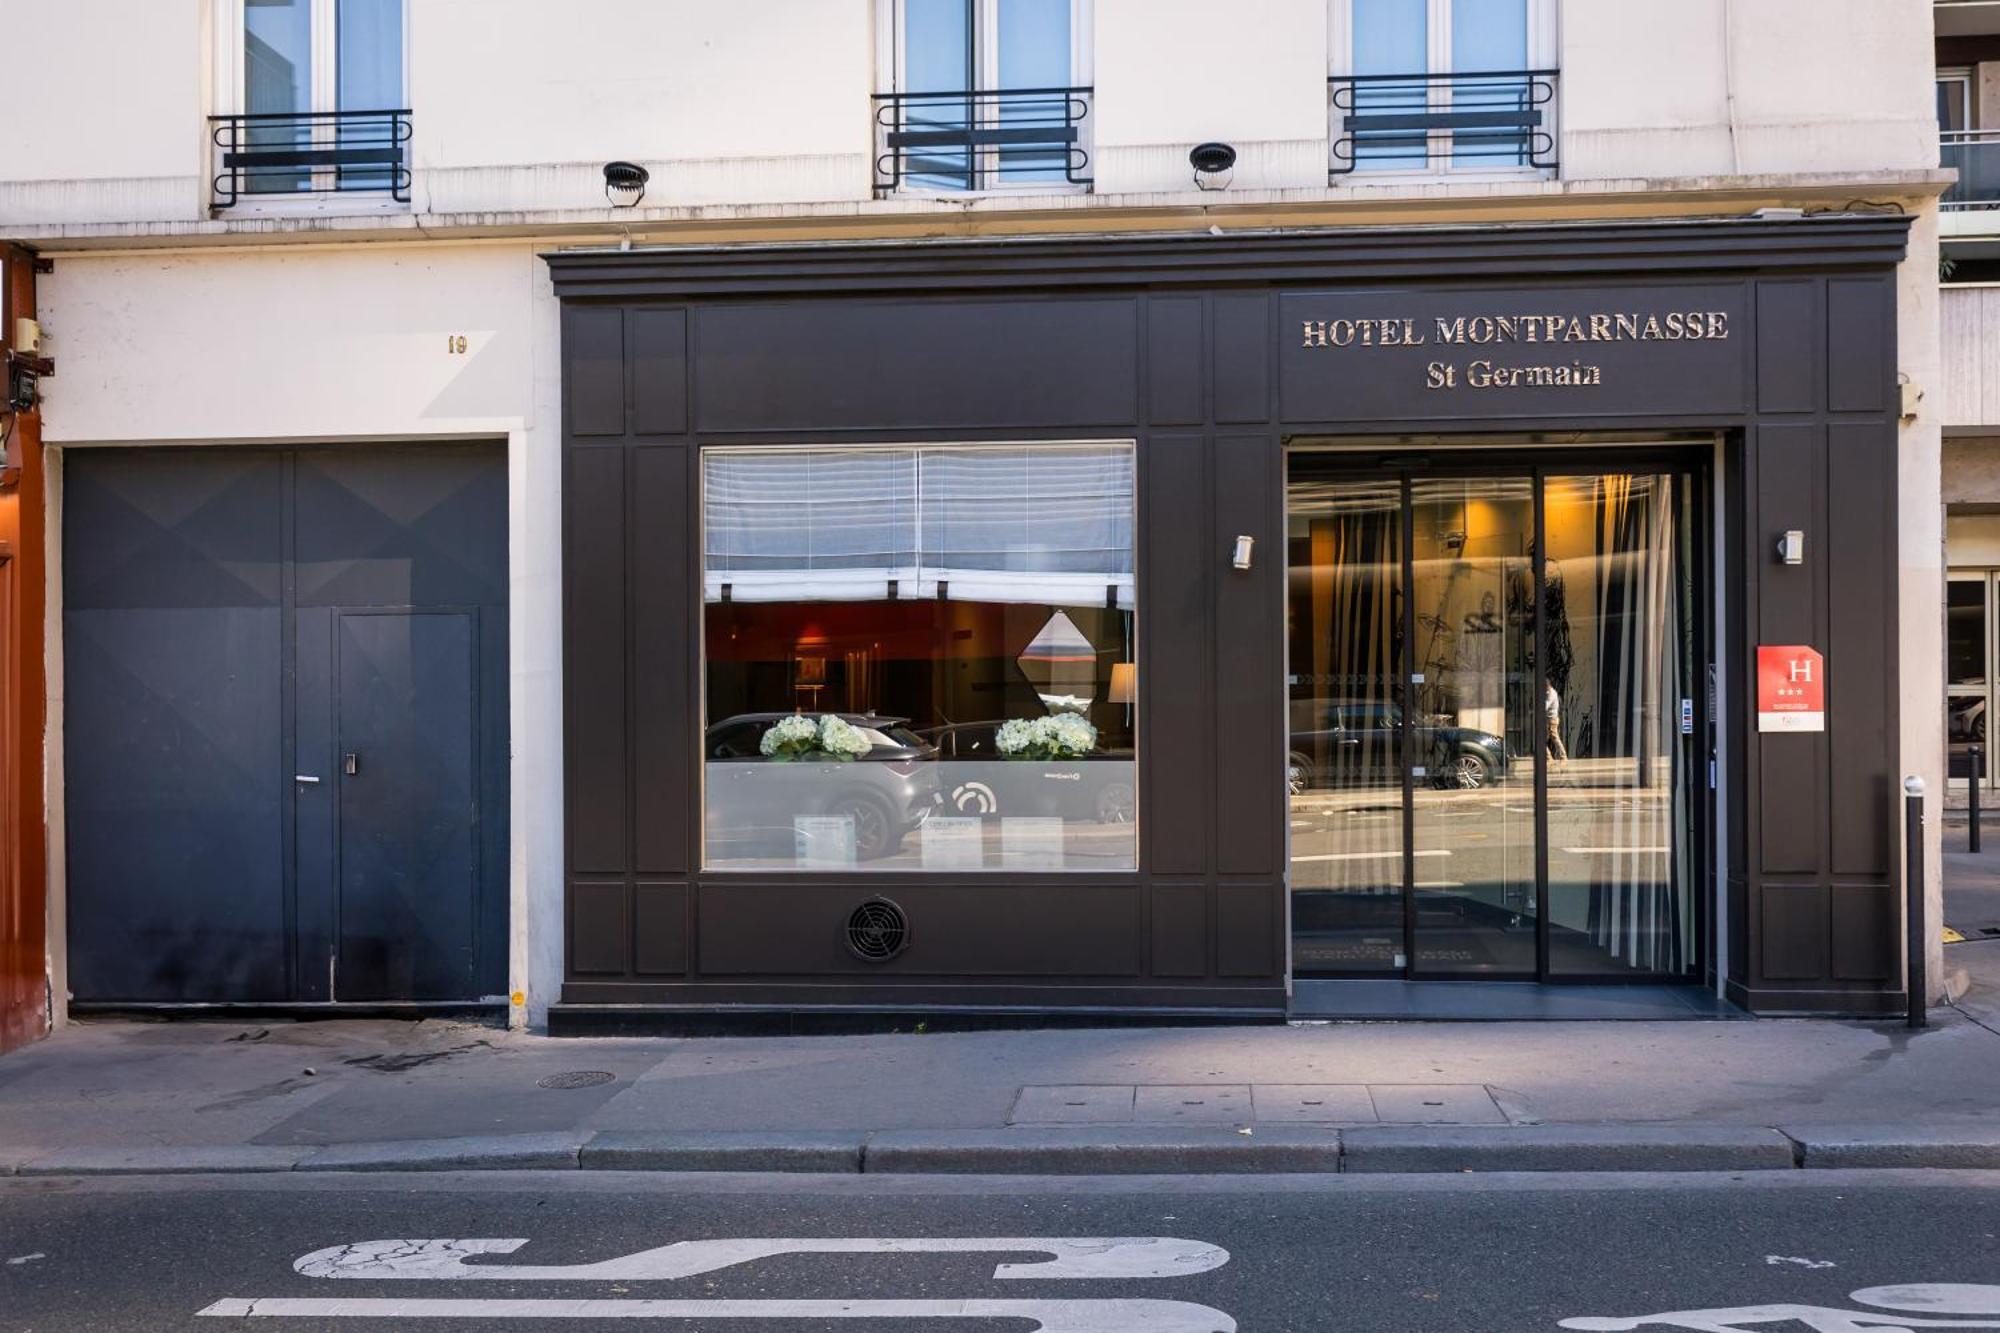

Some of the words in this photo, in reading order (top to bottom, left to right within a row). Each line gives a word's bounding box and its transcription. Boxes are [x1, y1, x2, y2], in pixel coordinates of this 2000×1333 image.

[1302, 319, 1425, 348] HOTEL
[1434, 311, 1729, 345] MONTPARNASSE
[448, 335, 468, 354] 19
[1426, 361, 1456, 388] St
[1466, 358, 1601, 388] Germain
[1789, 659, 1813, 683] H
